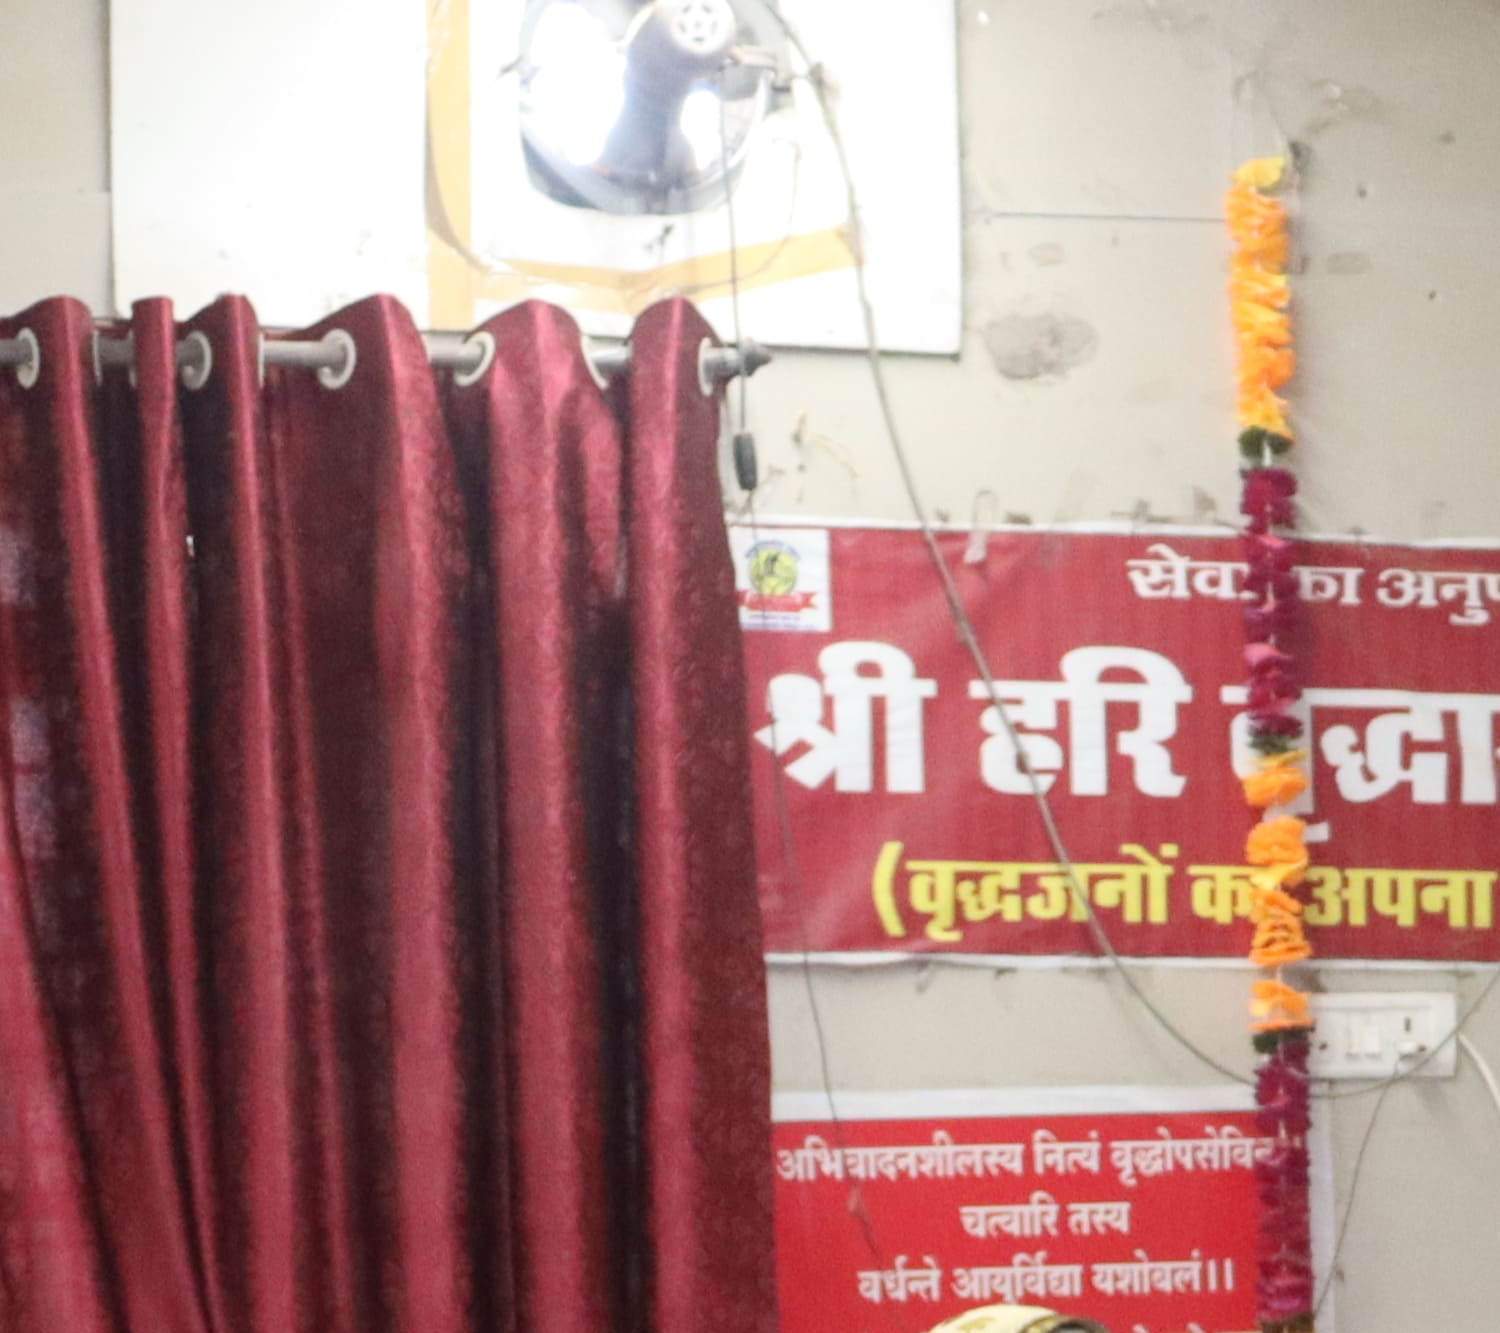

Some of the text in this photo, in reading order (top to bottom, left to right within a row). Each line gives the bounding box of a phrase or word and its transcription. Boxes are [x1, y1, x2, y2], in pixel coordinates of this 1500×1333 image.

[753, 640, 938, 794] श्री
[967, 645, 1194, 798] हरि
[873, 841, 1180, 942] (वृद्धजनों
[1303, 866, 1498, 929] अपना
[776, 1130, 1025, 1182] अभिवादनशीलस्य
[1032, 1128, 1102, 1175] नित्यं
[959, 1189, 1132, 1238] चत्वारि तस्य
